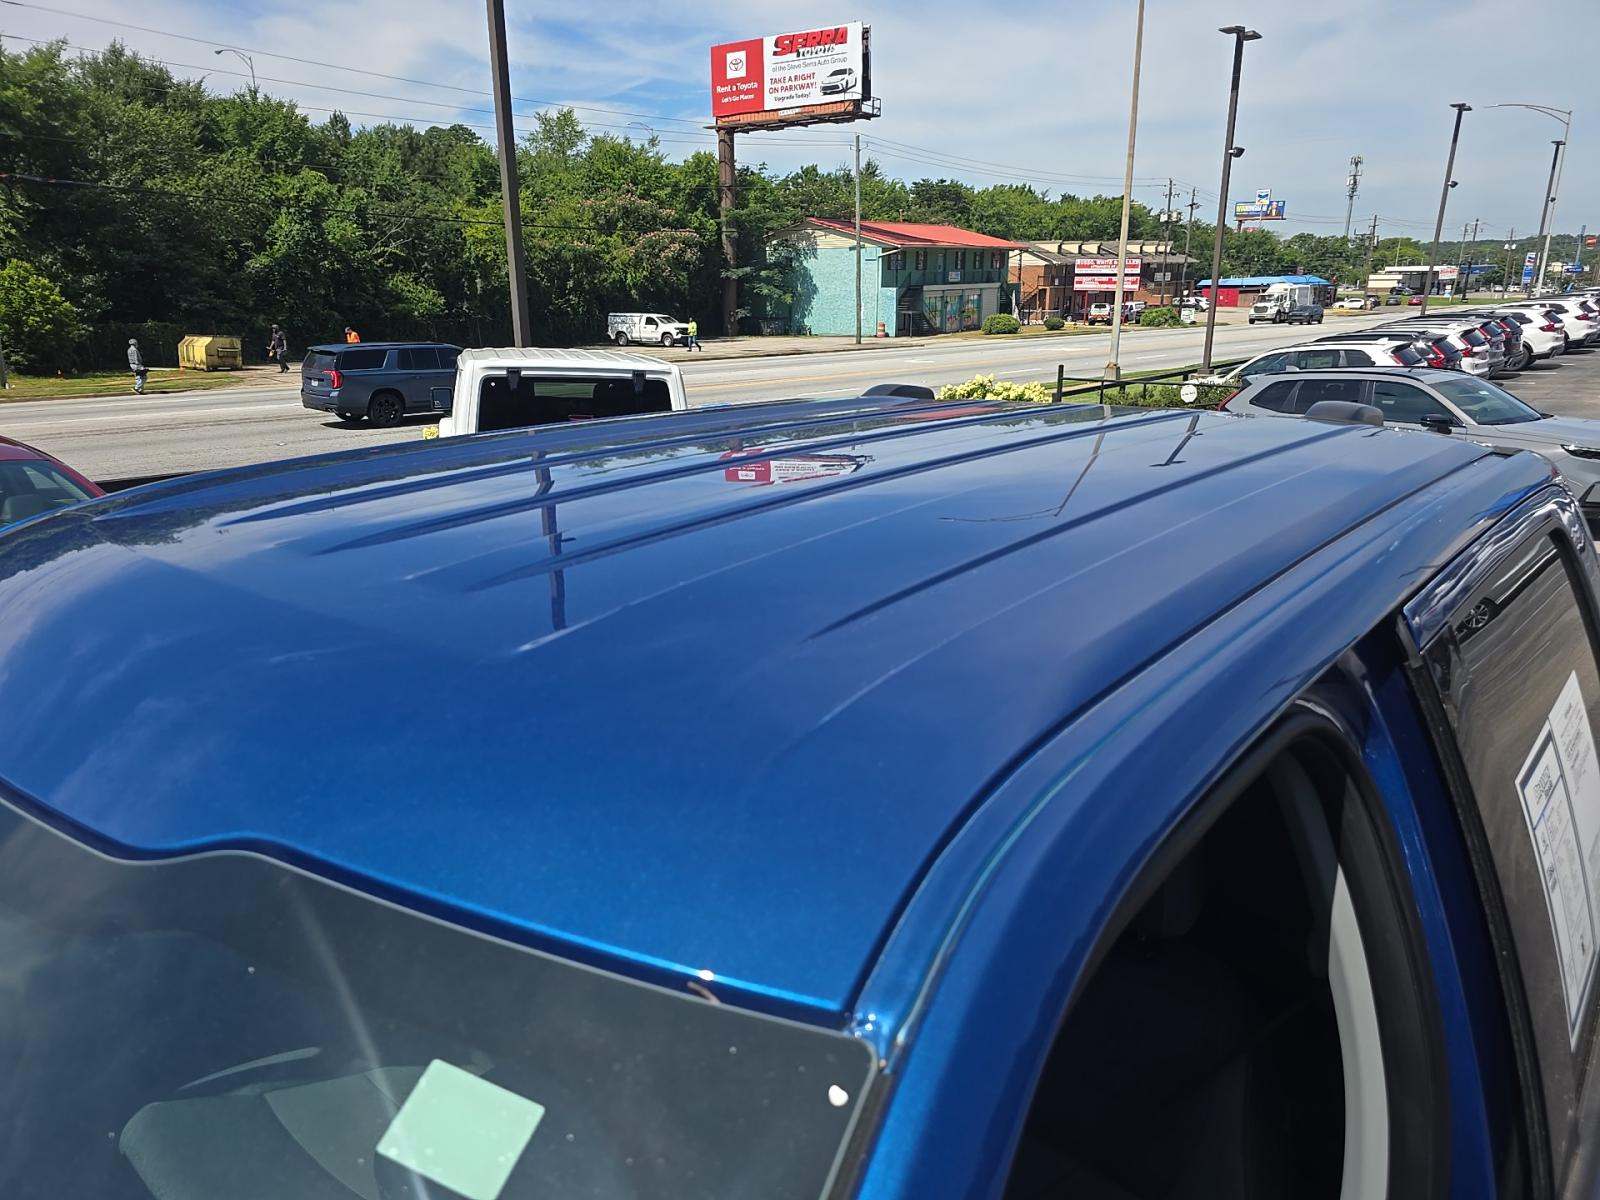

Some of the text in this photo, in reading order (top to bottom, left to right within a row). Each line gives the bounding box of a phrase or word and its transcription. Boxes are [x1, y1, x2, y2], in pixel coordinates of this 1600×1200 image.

[769, 72, 816, 85] TAKE A RIGHT
[716, 84, 731, 94] Rent
[736, 82, 758, 92] Toyota
[768, 81, 817, 95] ON PARKWAY!
